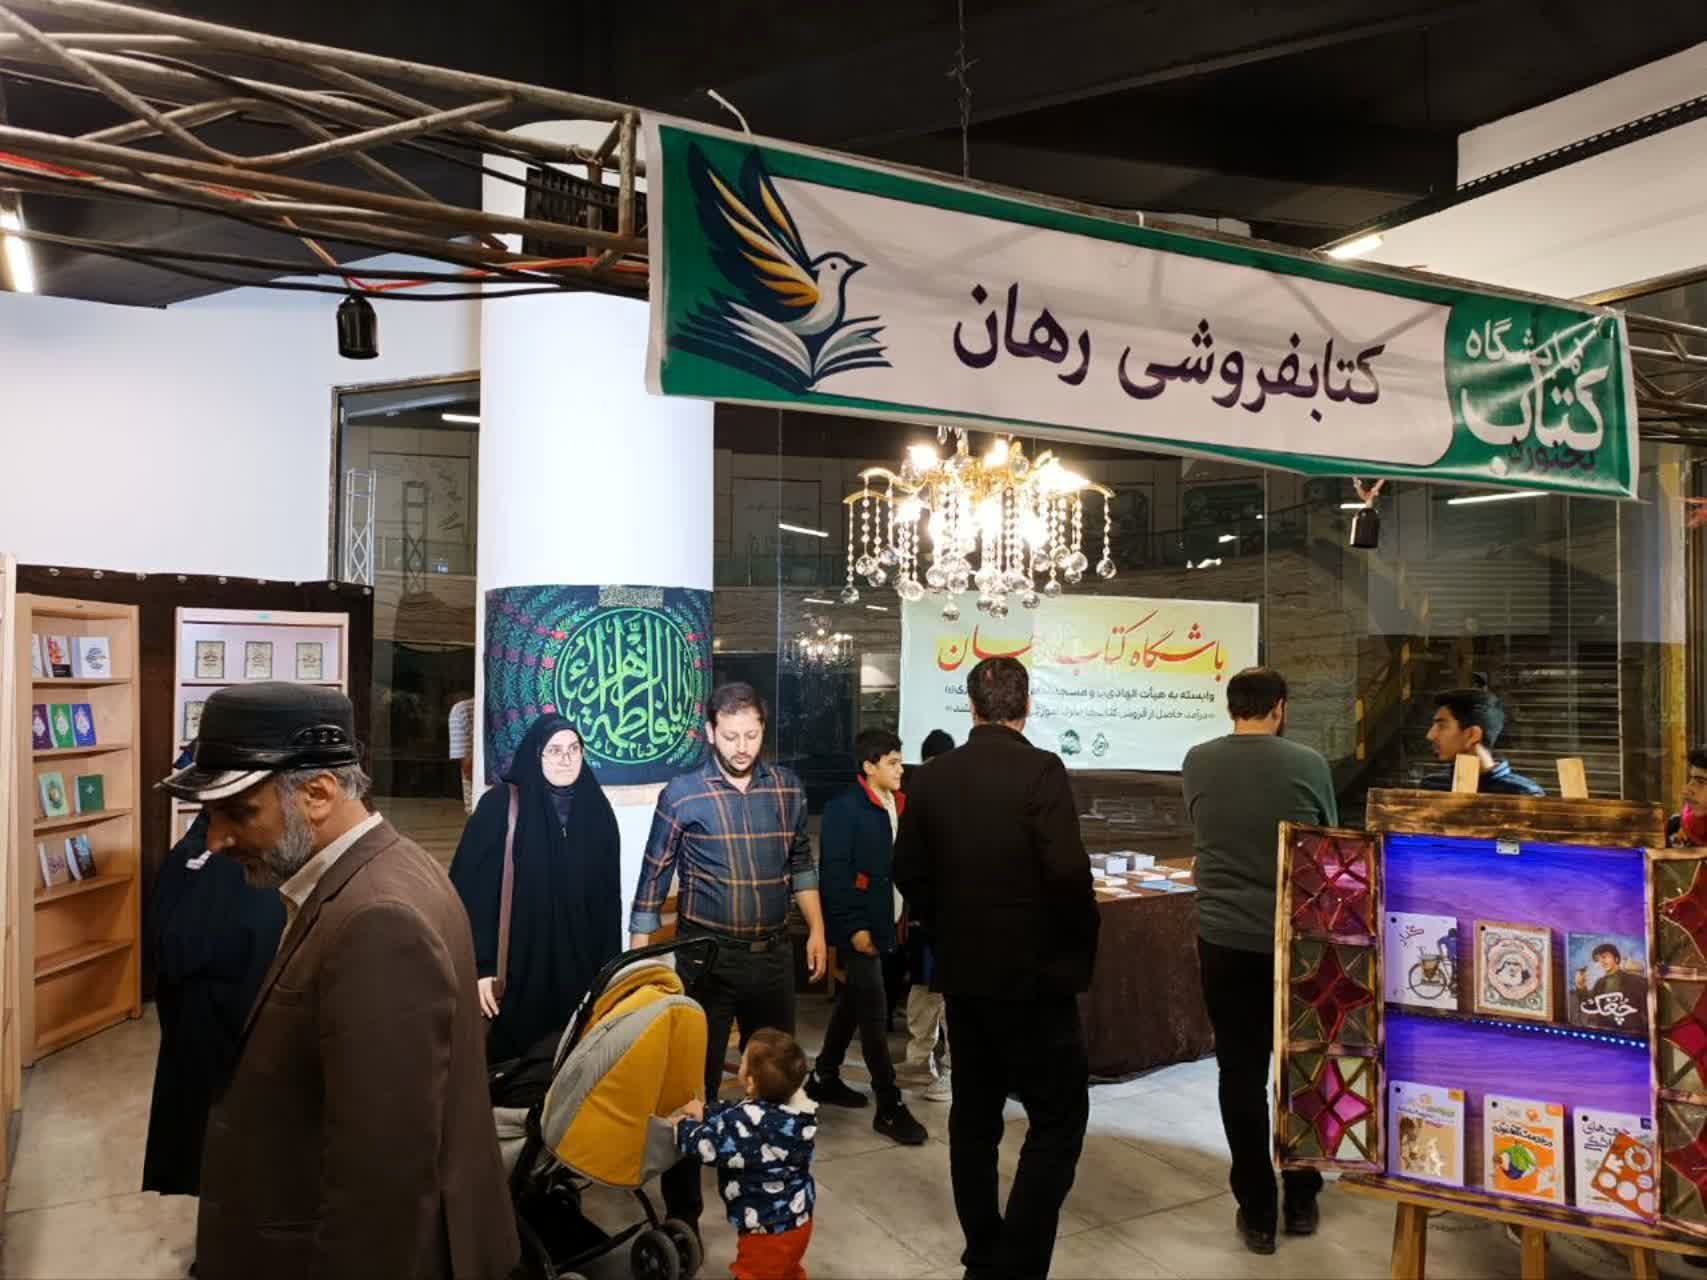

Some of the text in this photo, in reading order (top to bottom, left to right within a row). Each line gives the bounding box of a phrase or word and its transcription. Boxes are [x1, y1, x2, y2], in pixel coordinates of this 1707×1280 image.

[953, 282, 1385, 423] کتابفروشی رهان
[1466, 316, 1584, 375] نمایشگاه
[1461, 366, 1609, 474] کتاب
[1130, 622, 1224, 682] باشگاه
